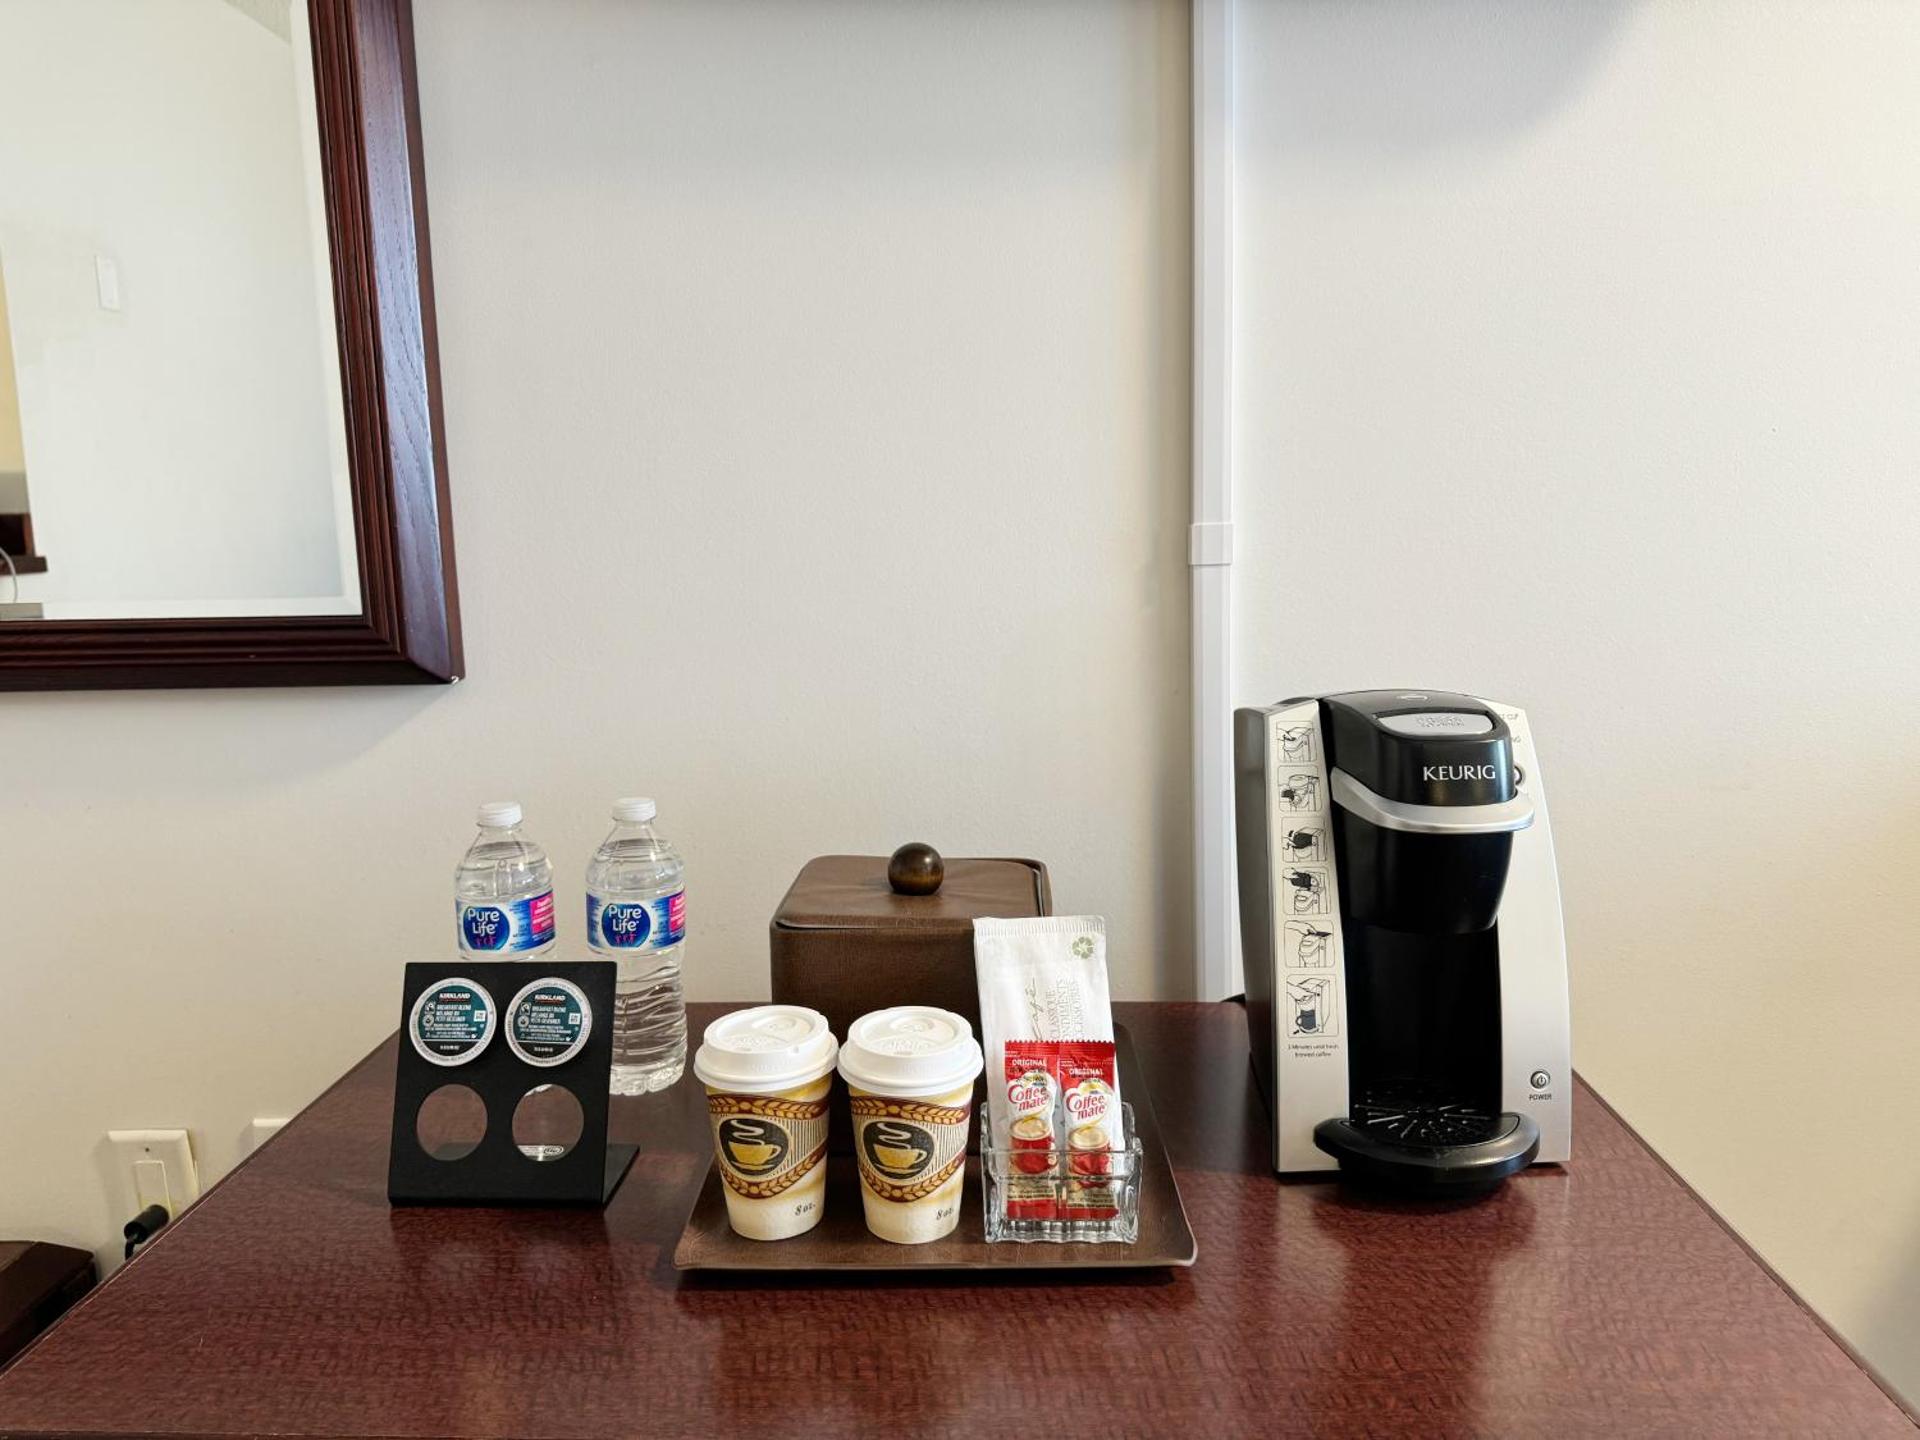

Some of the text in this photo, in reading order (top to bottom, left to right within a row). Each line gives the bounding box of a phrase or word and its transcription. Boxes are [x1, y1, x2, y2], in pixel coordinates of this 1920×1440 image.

[1423, 765, 1496, 781] KEURIG
[467, 907, 500, 922] Pure
[608, 904, 642, 919] Pure
[472, 921, 496, 937] Life
[612, 918, 637, 934] Life
[1008, 1084, 1047, 1104] Coffee
[1529, 1093, 1552, 1101] POWER
[1018, 1096, 1049, 1111] mate
[1065, 1093, 1105, 1112] Coffee
[1077, 1105, 1106, 1120] mate
[794, 1204, 802, 1216] 8
[936, 1209, 943, 1220] 8
